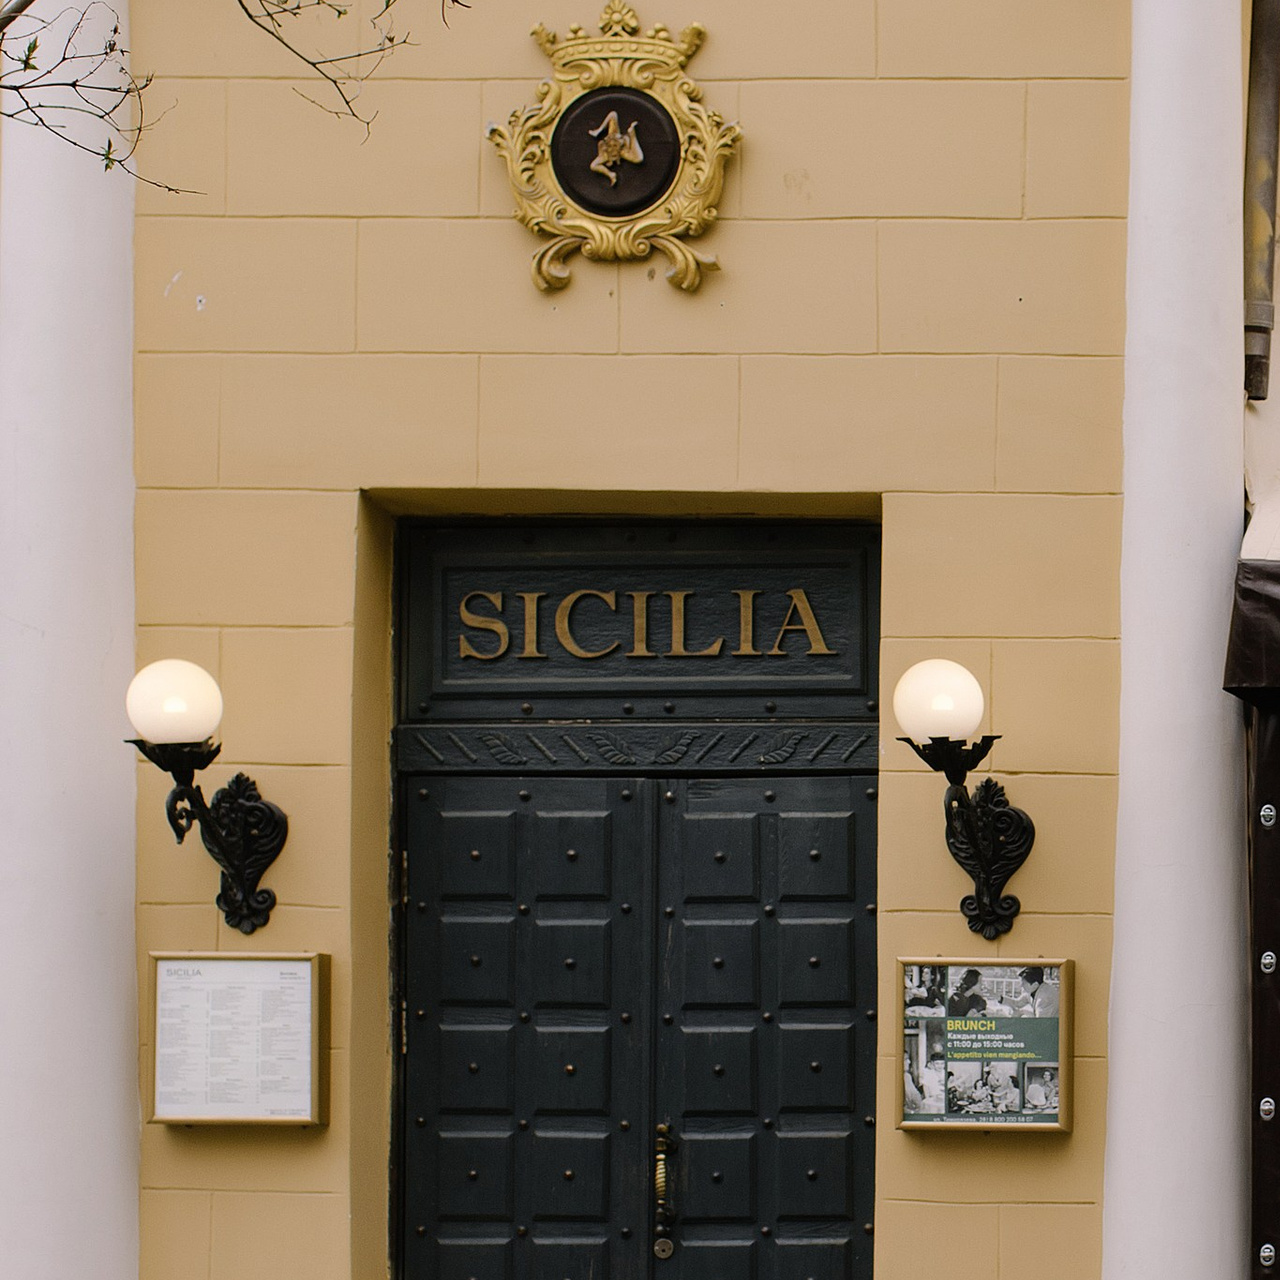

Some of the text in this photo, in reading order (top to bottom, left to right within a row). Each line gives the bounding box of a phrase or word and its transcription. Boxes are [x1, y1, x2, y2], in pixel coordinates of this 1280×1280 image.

[458, 588, 838, 660] SICILIA
[947, 1020, 996, 1031] BRUNCH
[947, 1032, 977, 1040] Каждые
